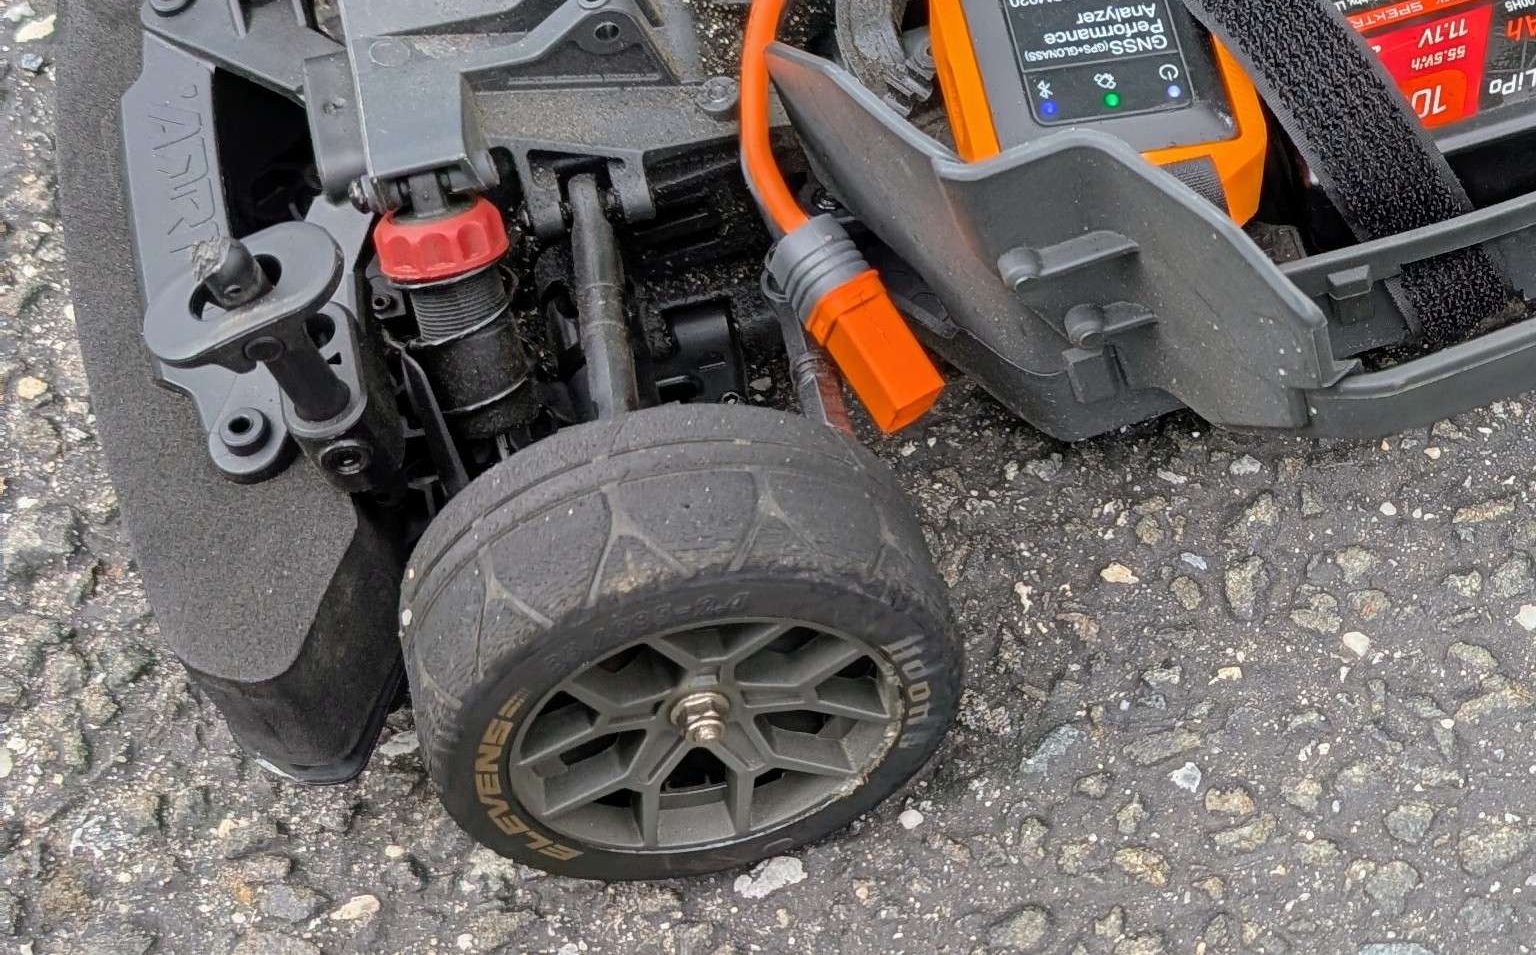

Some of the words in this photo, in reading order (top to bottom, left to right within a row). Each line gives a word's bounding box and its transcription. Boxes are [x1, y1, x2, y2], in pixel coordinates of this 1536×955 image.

[1076, 3, 1157, 25] Analyzer
[1350, 0, 1424, 30] SPEKTR
[1044, 18, 1164, 45] Performance
[1417, 19, 1469, 48] 11.1V
[1411, 45, 1466, 70] 55.5Wh
[1411, 85, 1447, 118] 10
